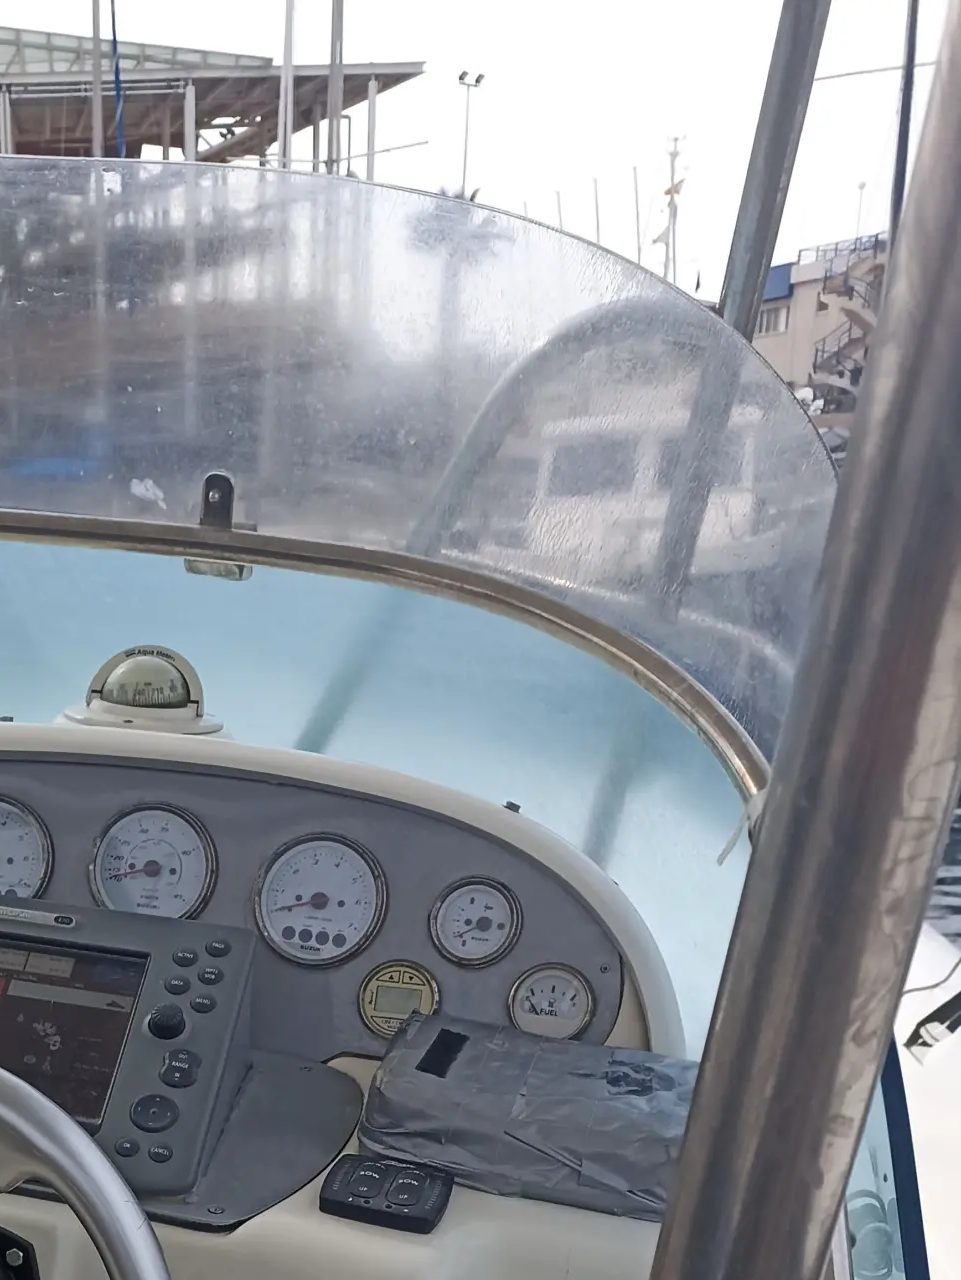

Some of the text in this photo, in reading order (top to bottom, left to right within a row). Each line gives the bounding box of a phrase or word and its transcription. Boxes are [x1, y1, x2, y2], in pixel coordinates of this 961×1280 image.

[136, 648, 155, 656] Aqua
[195, 997, 211, 1005] MENU
[539, 1007, 559, 1017] FUEL
[171, 1061, 189, 1069] RANGE
[150, 1146, 169, 1156] CANCEL
